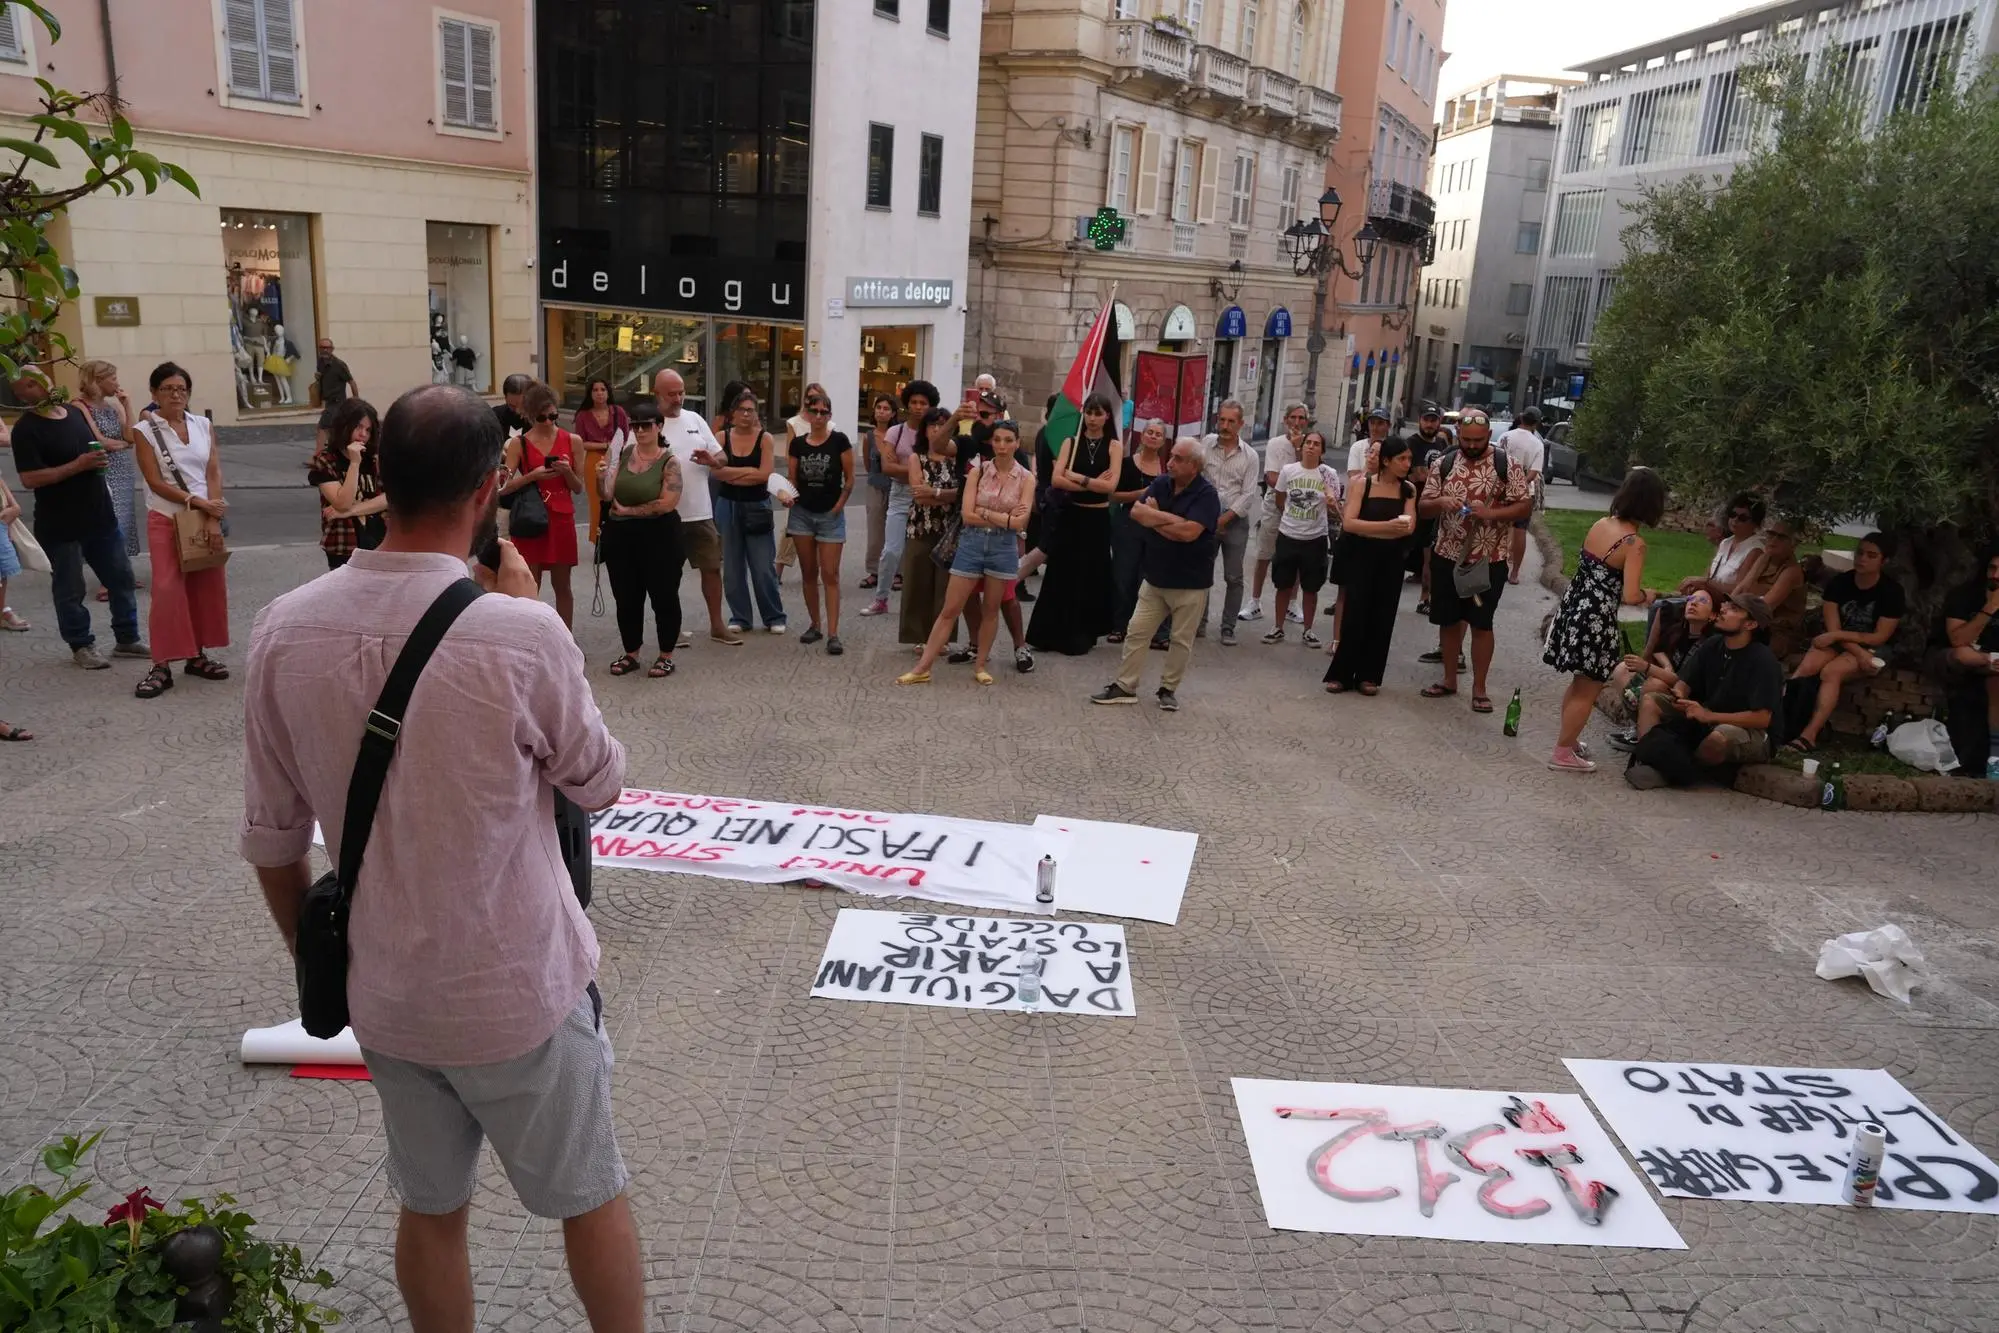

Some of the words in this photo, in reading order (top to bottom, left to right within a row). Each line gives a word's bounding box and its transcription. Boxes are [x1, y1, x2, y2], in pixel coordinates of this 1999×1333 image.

[551, 259, 790, 311] delogu
[854, 280, 898, 300] ottica
[905, 282, 950, 304] delogu
[711, 816, 795, 846] NEI
[803, 823, 948, 862] FASCI
[779, 855, 926, 887] UNICI
[899, 913, 1088, 939] UCCIDE
[904, 926, 1058, 957] STATO
[1072, 939, 1122, 959] LO
[813, 958, 1017, 1006] GIULIANI
[1085, 958, 1122, 984] A
[1040, 983, 1123, 1012] DA
[1623, 1065, 1851, 1099] STATO
[1687, 1101, 1745, 1127] DI
